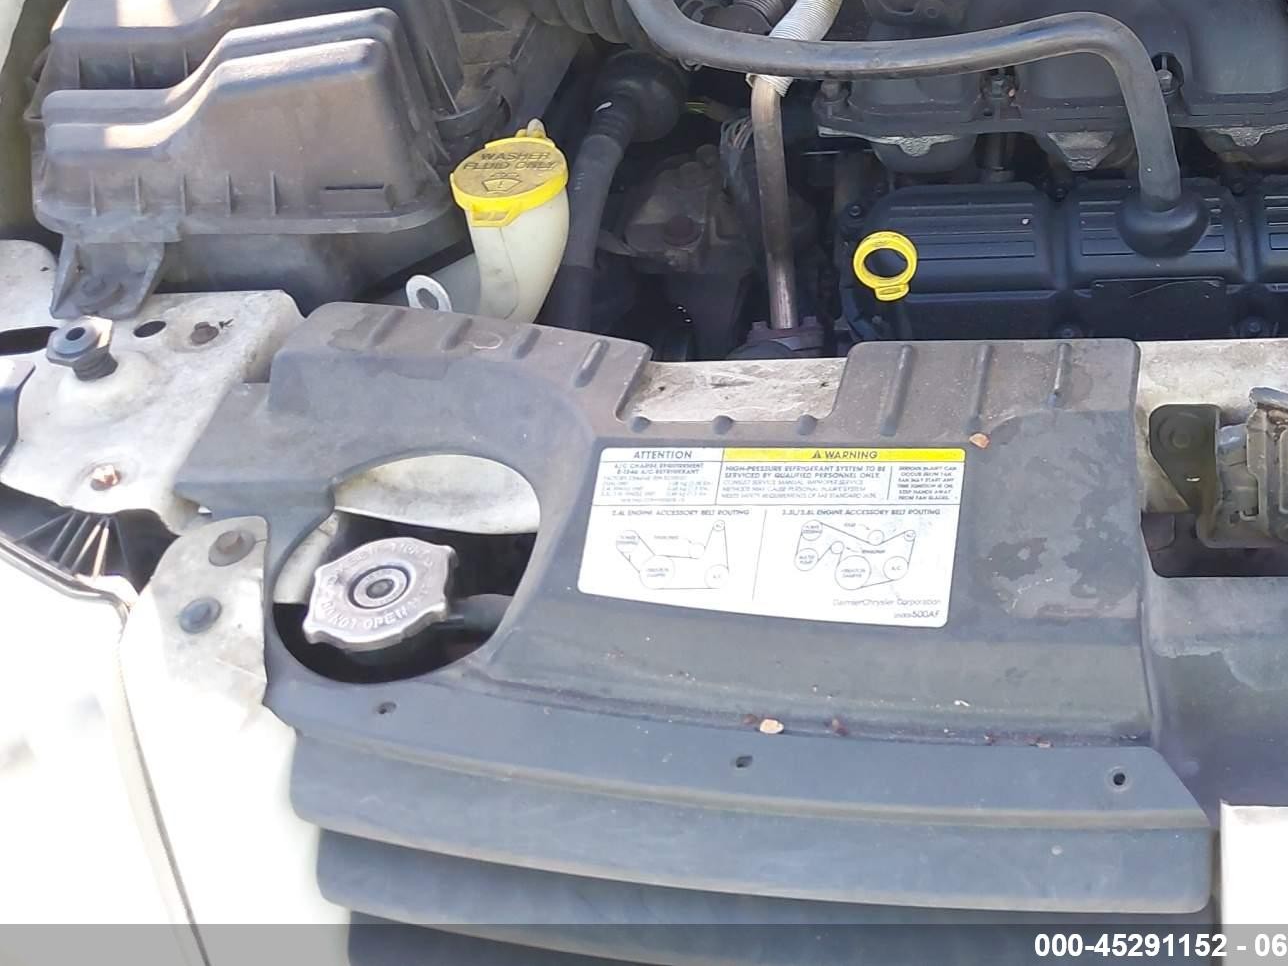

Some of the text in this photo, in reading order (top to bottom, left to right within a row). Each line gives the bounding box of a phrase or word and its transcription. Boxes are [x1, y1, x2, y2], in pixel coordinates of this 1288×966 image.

[480, 152, 551, 161] WASHER
[463, 161, 558, 170] FLUID ONLY
[633, 451, 693, 459] ATTENTION
[824, 450, 878, 459] WARNING
[363, 605, 409, 630] OPEN
